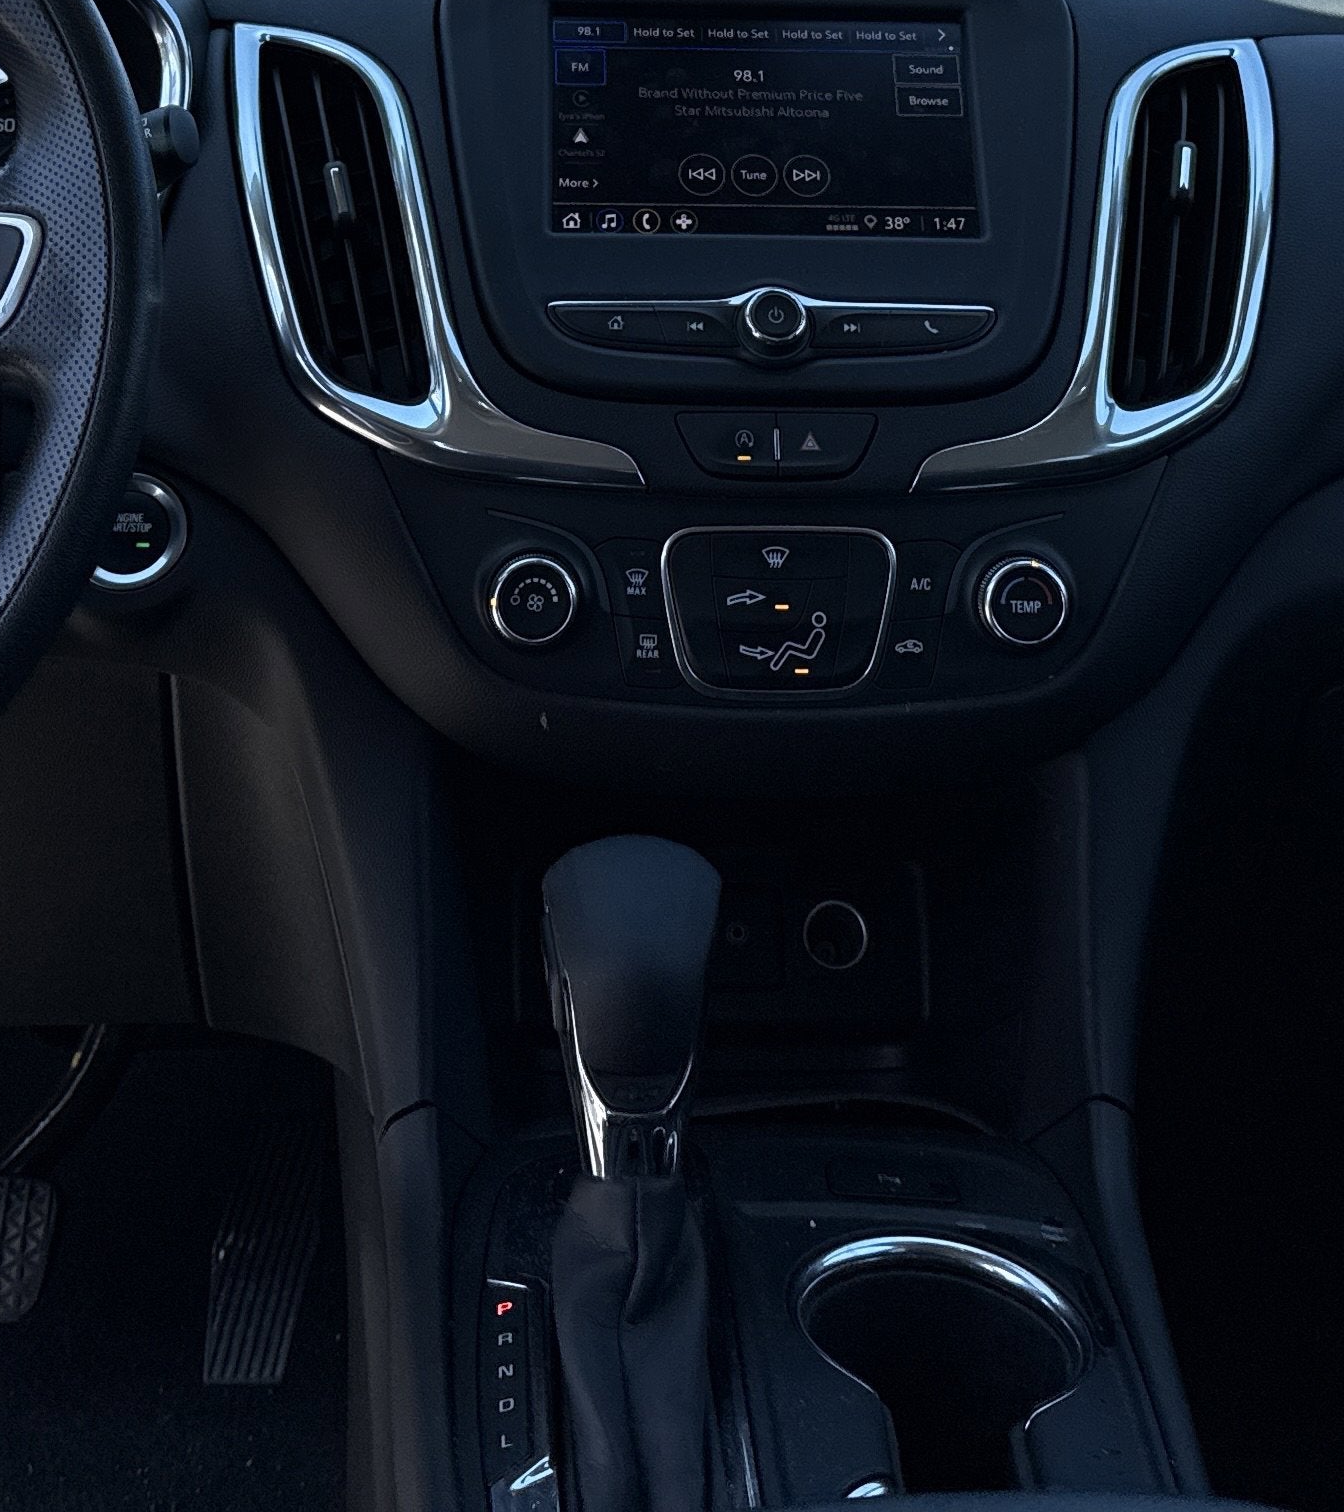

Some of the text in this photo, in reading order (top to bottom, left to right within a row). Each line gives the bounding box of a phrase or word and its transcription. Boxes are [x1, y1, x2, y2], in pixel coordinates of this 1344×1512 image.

[577, 26, 601, 36] 98.1
[633, 27, 696, 38] Hold to Set
[707, 28, 770, 39] Hold to Set
[782, 30, 844, 41] Hold to Set
[856, 31, 918, 42] Hold to Set
[571, 63, 590, 73] FM
[908, 64, 944, 75] Sound
[733, 70, 765, 83] 98.1
[638, 87, 864, 102] Brand Without Premium Price Five
[909, 96, 949, 106] Browse
[674, 104, 702, 116] Star
[704, 105, 775, 117] Mitsubishi
[740, 169, 768, 180] Tune
[559, 177, 590, 189] More
[884, 216, 911, 230] 38°
[933, 217, 966, 231] 1:47
[116, 512, 144, 522] NGINE
[112, 523, 152, 533] ART/STOP
[910, 576, 932, 592] A/C
[625, 585, 647, 596] MAX
[1009, 599, 1044, 615] TEMP
[636, 647, 661, 659] REAR
[496, 1301, 513, 1316] P
[497, 1331, 513, 1347] R
[498, 1363, 514, 1379] N
[498, 1397, 515, 1413] D
[500, 1434, 513, 1449] L
